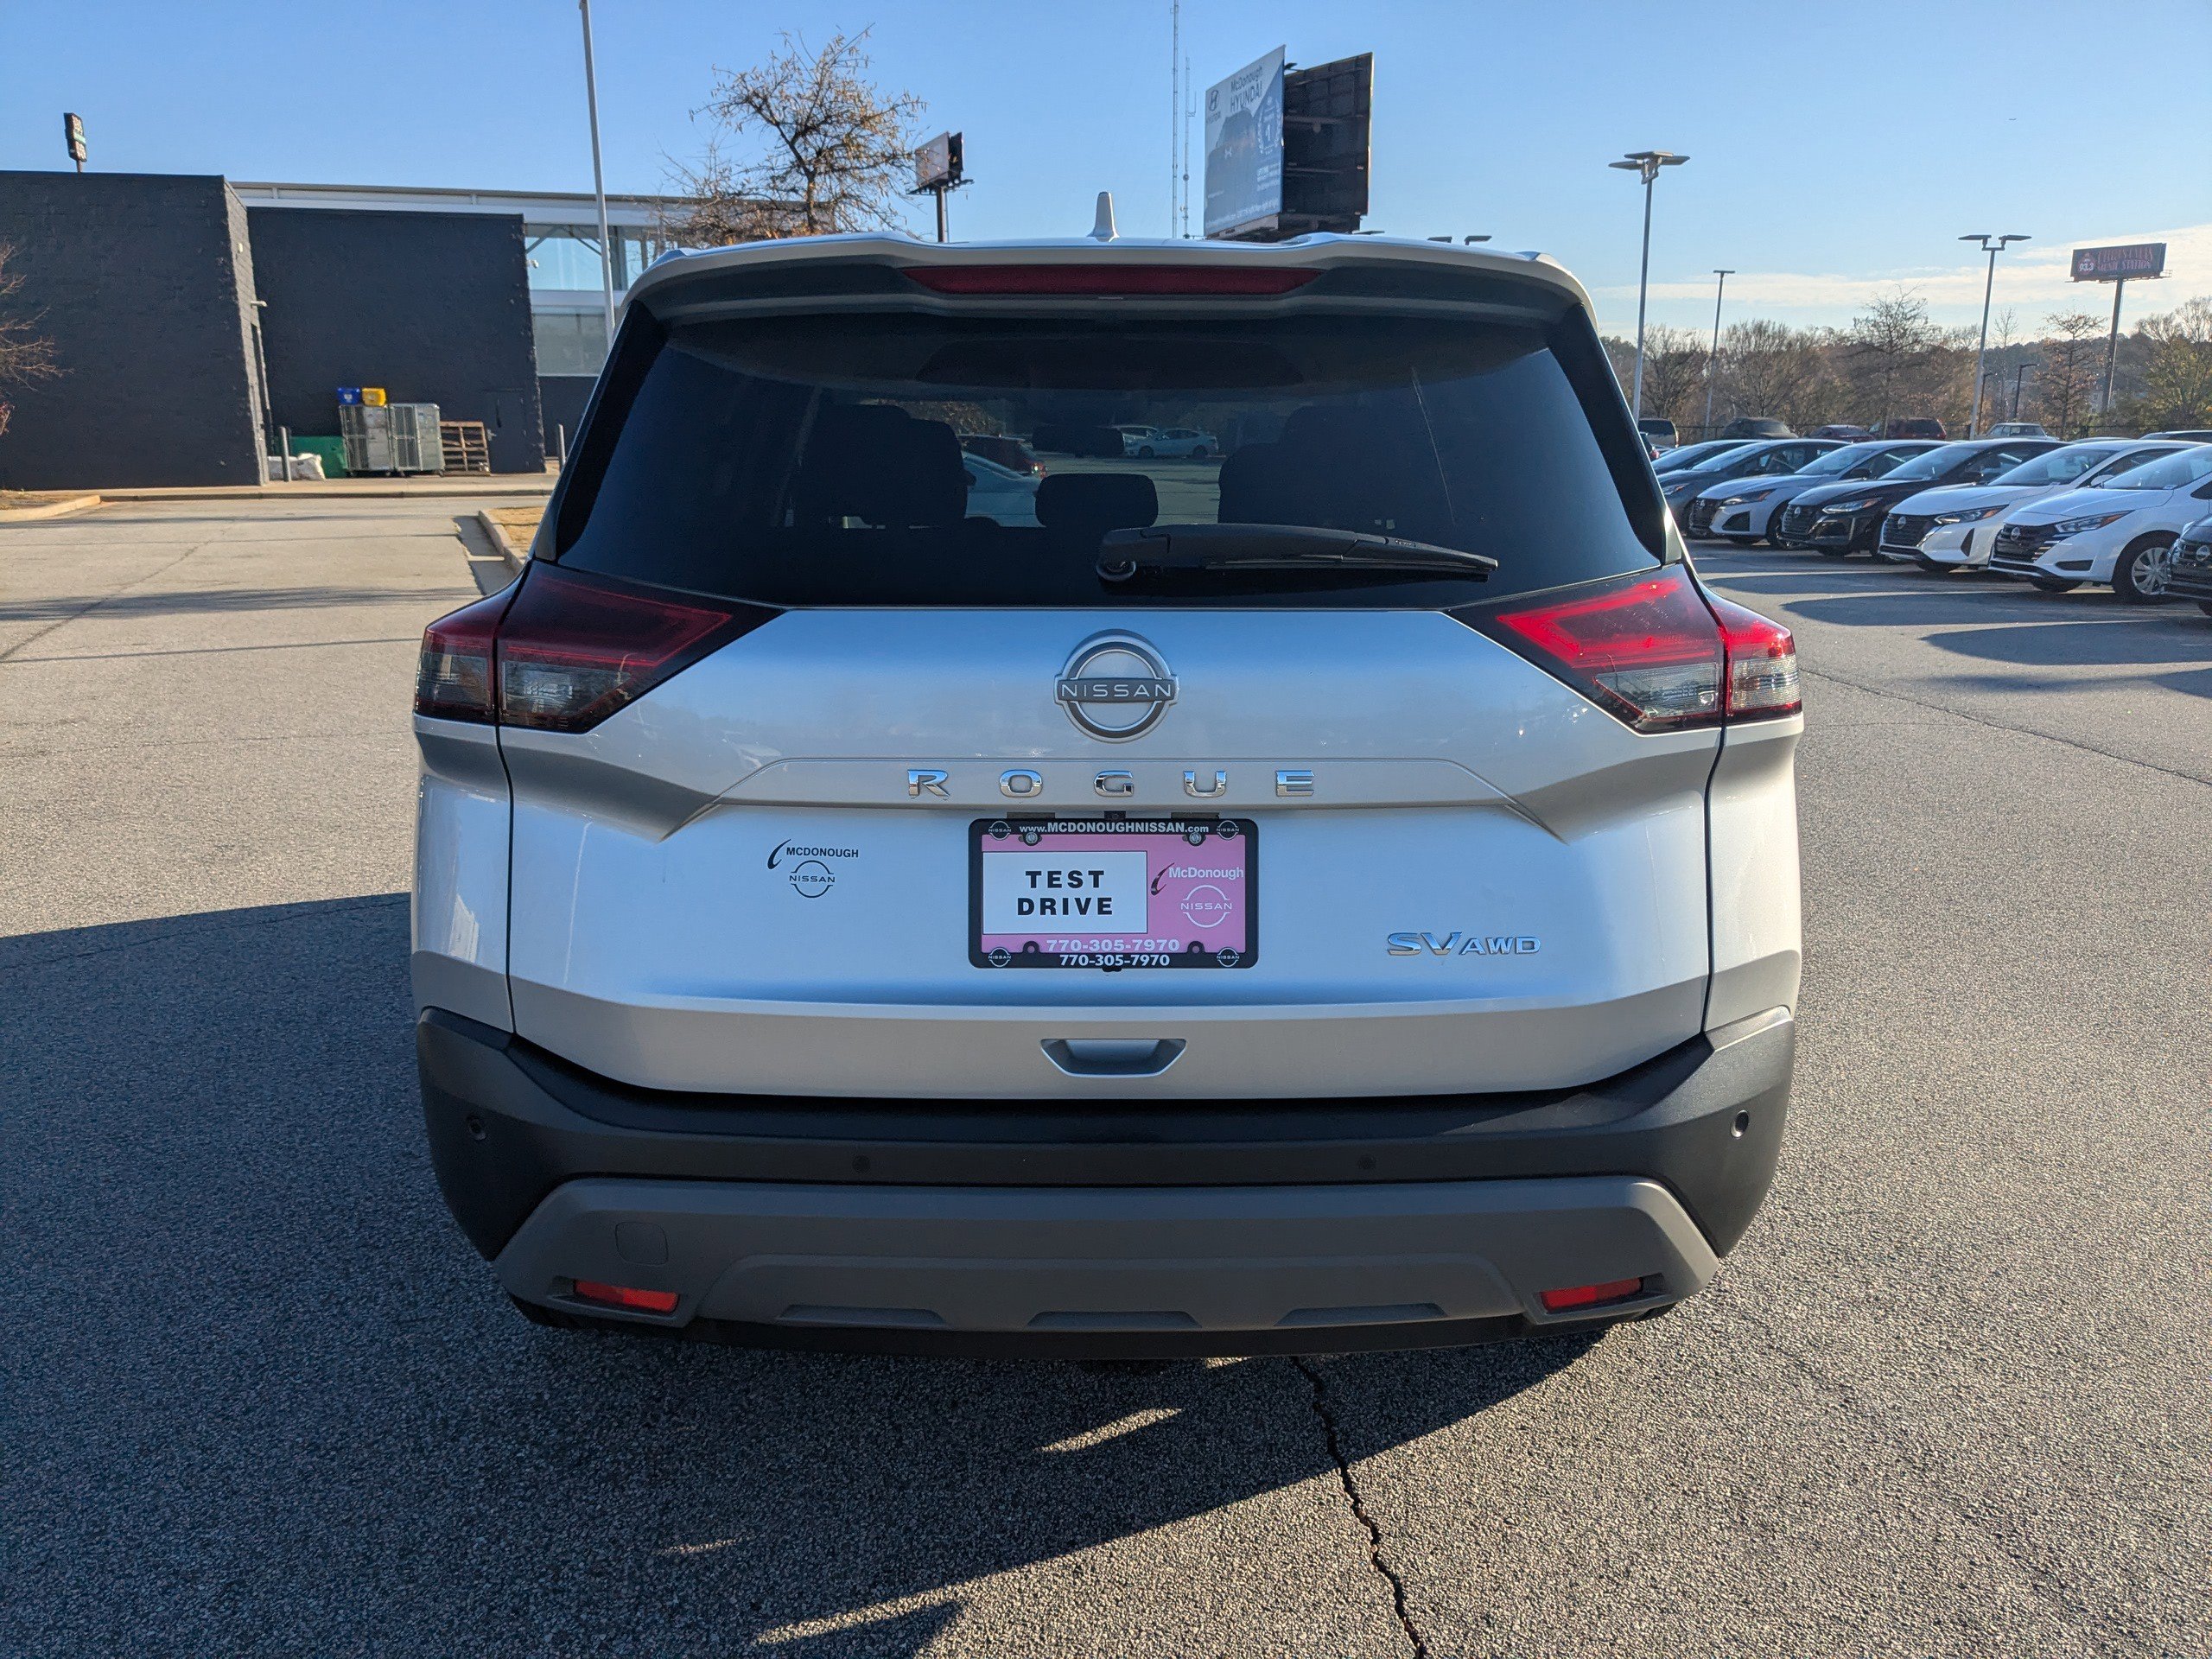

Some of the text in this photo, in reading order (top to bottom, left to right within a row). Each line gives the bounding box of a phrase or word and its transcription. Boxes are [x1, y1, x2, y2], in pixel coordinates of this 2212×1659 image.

[1230, 79, 1262, 113] HYUNDAI
[1061, 683, 1171, 697] NISSAN
[906, 768, 1315, 799] ROGUE
[1019, 822, 1210, 833] www.MCDONOUGHNISSAN.com
[786, 847, 859, 858] MCDONOUGH
[789, 874, 836, 883] NISSAN
[1025, 870, 1105, 888] TEST
[1168, 867, 1244, 880] McDonough
[1017, 897, 1113, 916] DRIVE
[1046, 938, 1179, 951] 770-305-7970
[1387, 931, 1541, 956] SV AWD
[1059, 954, 1171, 966] 770-305-7970
